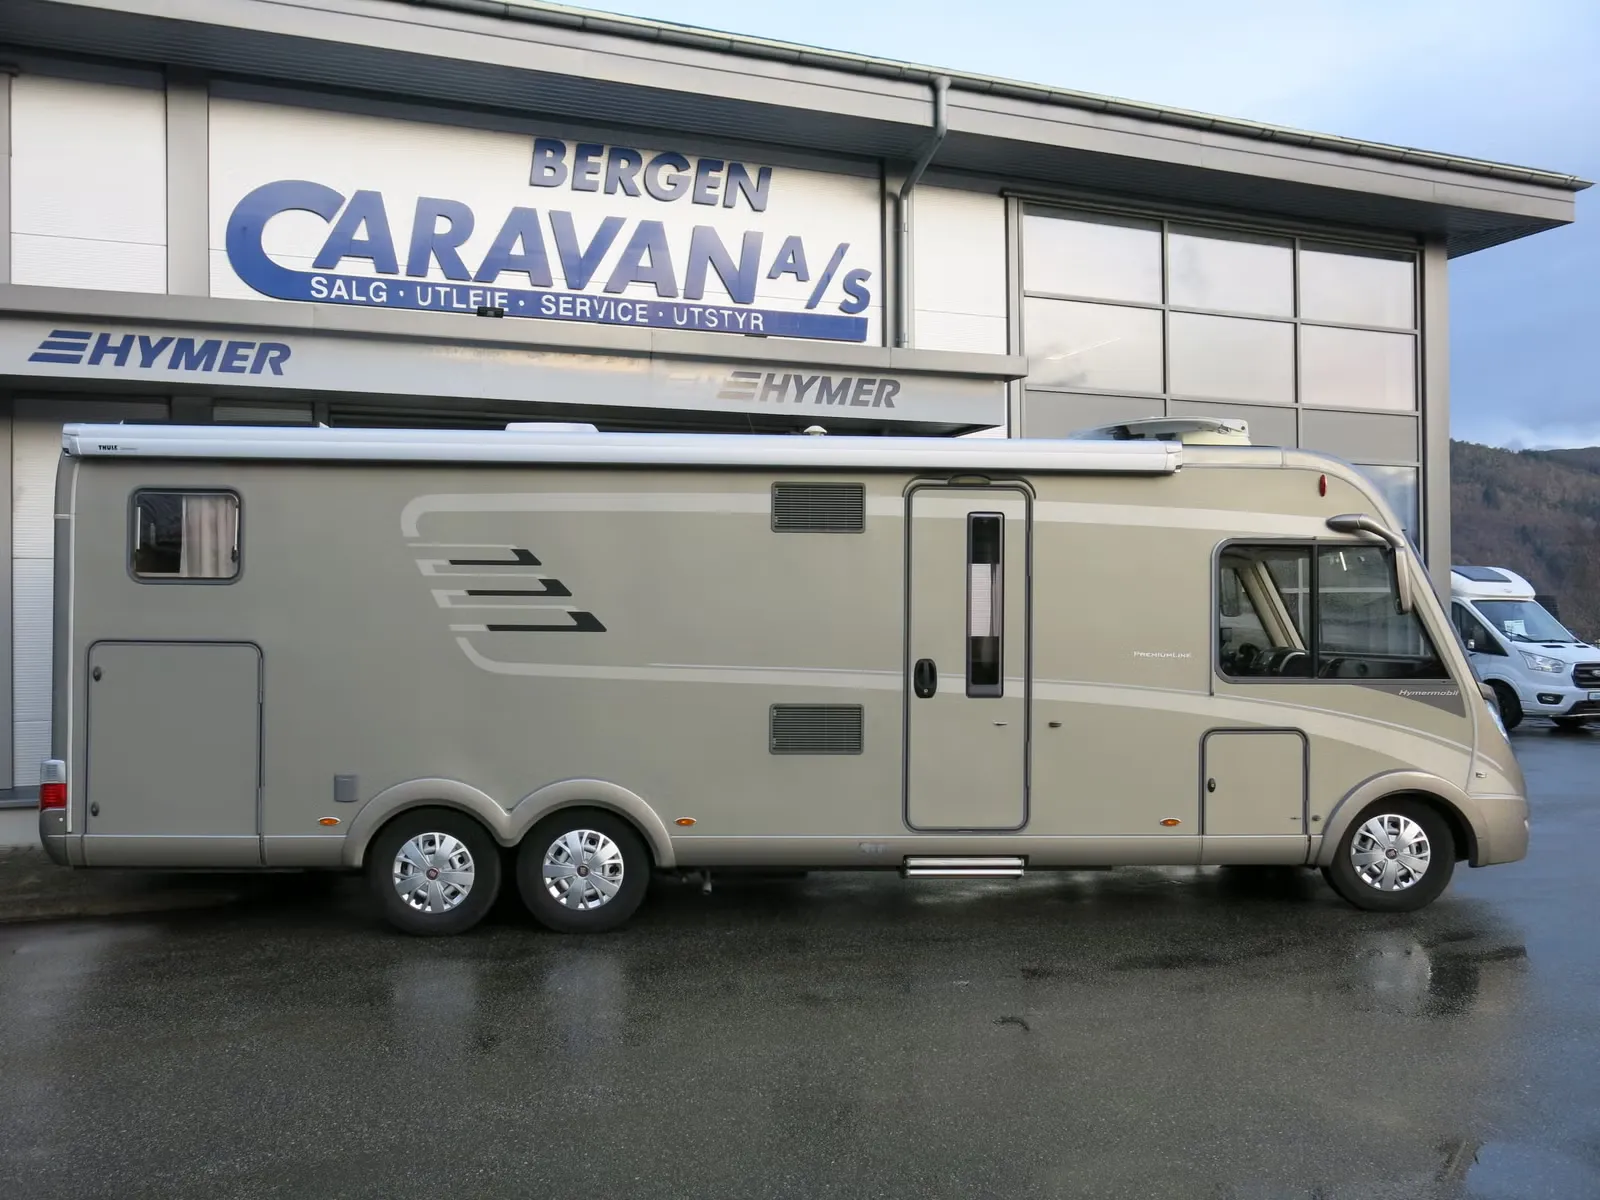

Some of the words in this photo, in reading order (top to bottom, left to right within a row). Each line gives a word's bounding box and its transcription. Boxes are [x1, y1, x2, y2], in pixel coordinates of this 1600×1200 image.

[529, 137, 773, 213] BERGEN
[225, 179, 764, 305] CARAVAN
[766, 235, 872, 314] A/S
[310, 276, 388, 303] SALG
[416, 286, 509, 312] UTLEIE
[540, 294, 649, 323] SERVICE
[673, 306, 765, 331] UTSTYR
[87, 332, 292, 376] HYMER
[759, 372, 901, 409] HYMER
[1398, 689, 1459, 697] Hymermobil
